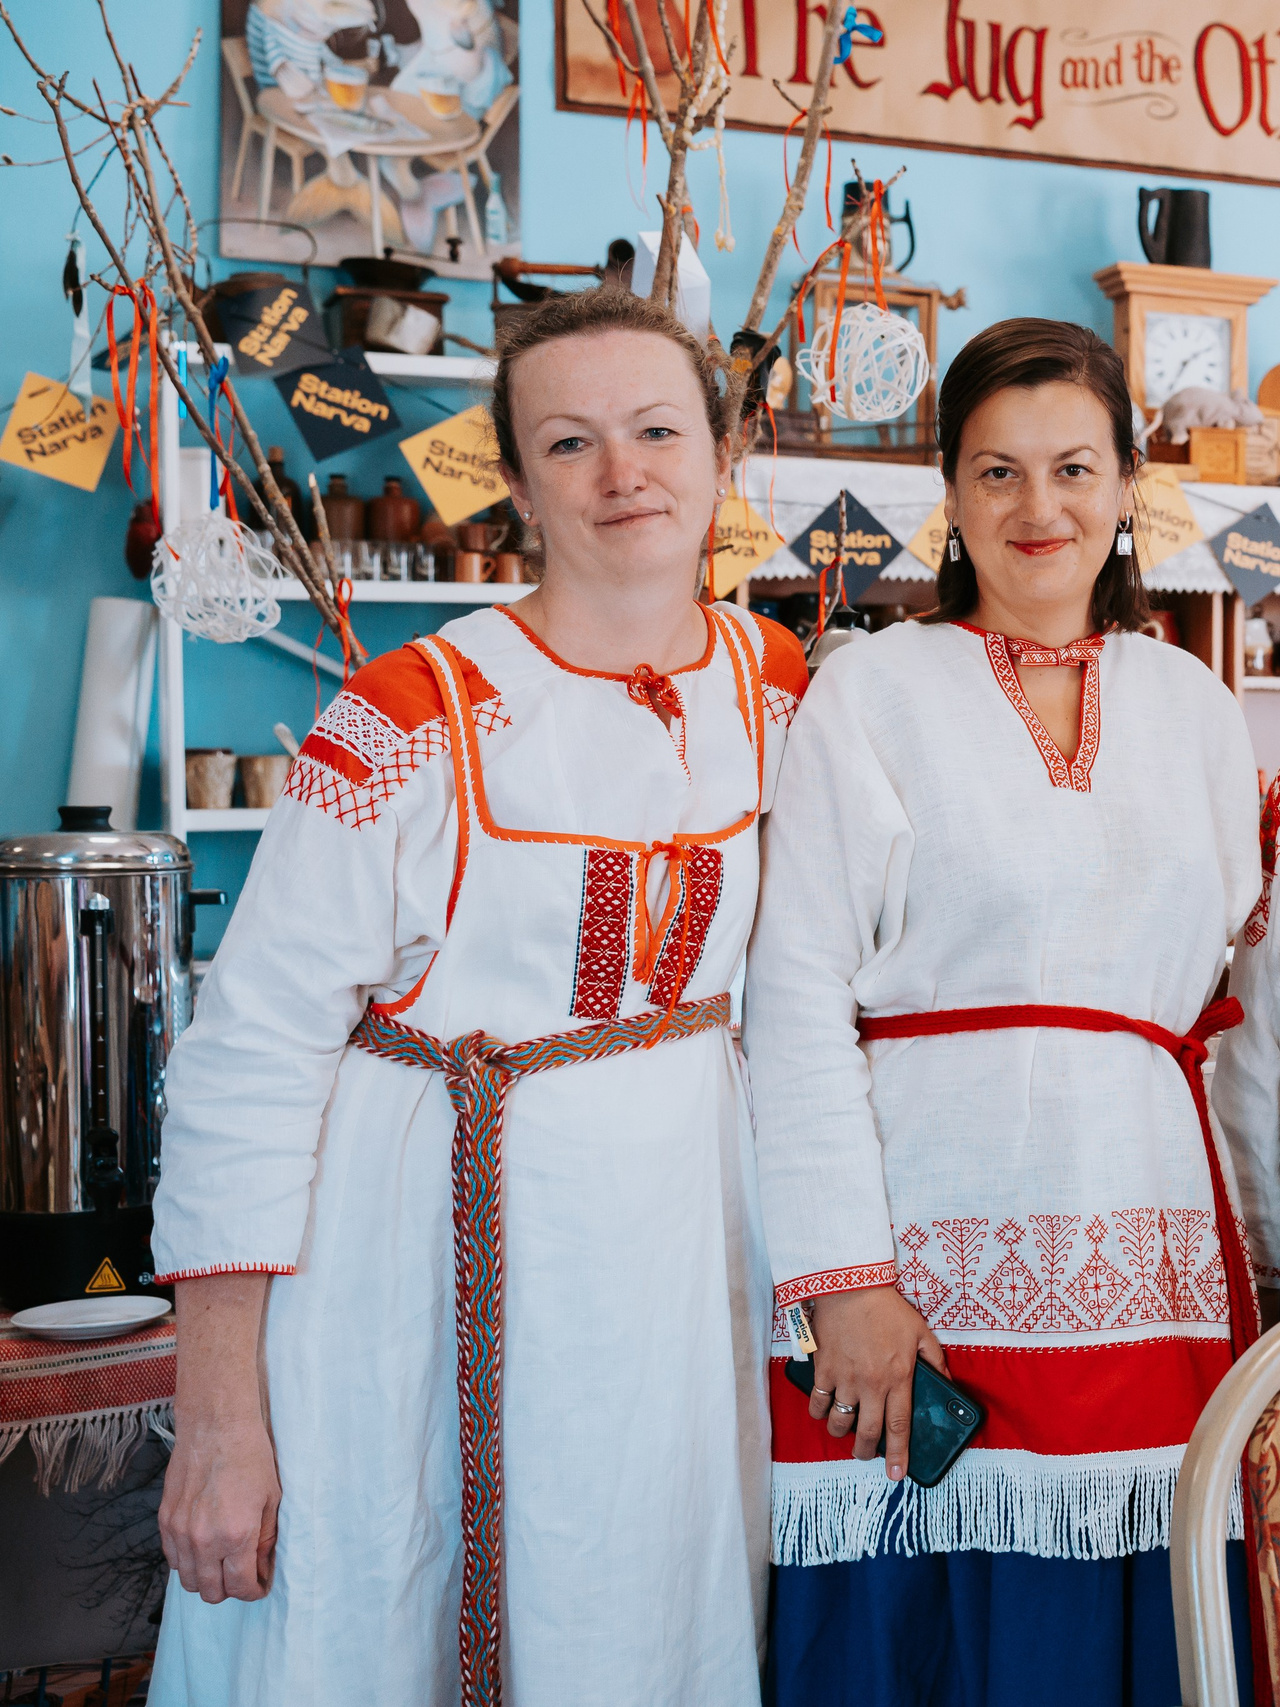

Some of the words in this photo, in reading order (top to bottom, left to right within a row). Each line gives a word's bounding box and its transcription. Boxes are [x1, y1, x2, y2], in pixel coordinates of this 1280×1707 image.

[918, 0, 1049, 130] Jug
[1060, 42, 1122, 90] and
[1132, 38, 1182, 84] the
[237, 287, 299, 357] Station
[254, 306, 310, 368] Narva
[290, 388, 372, 434] Narva
[297, 372, 390, 421] Station
[24, 424, 104, 463] Narva
[788, 1309, 802, 1340] Narva
[794, 1307, 810, 1343] Station
